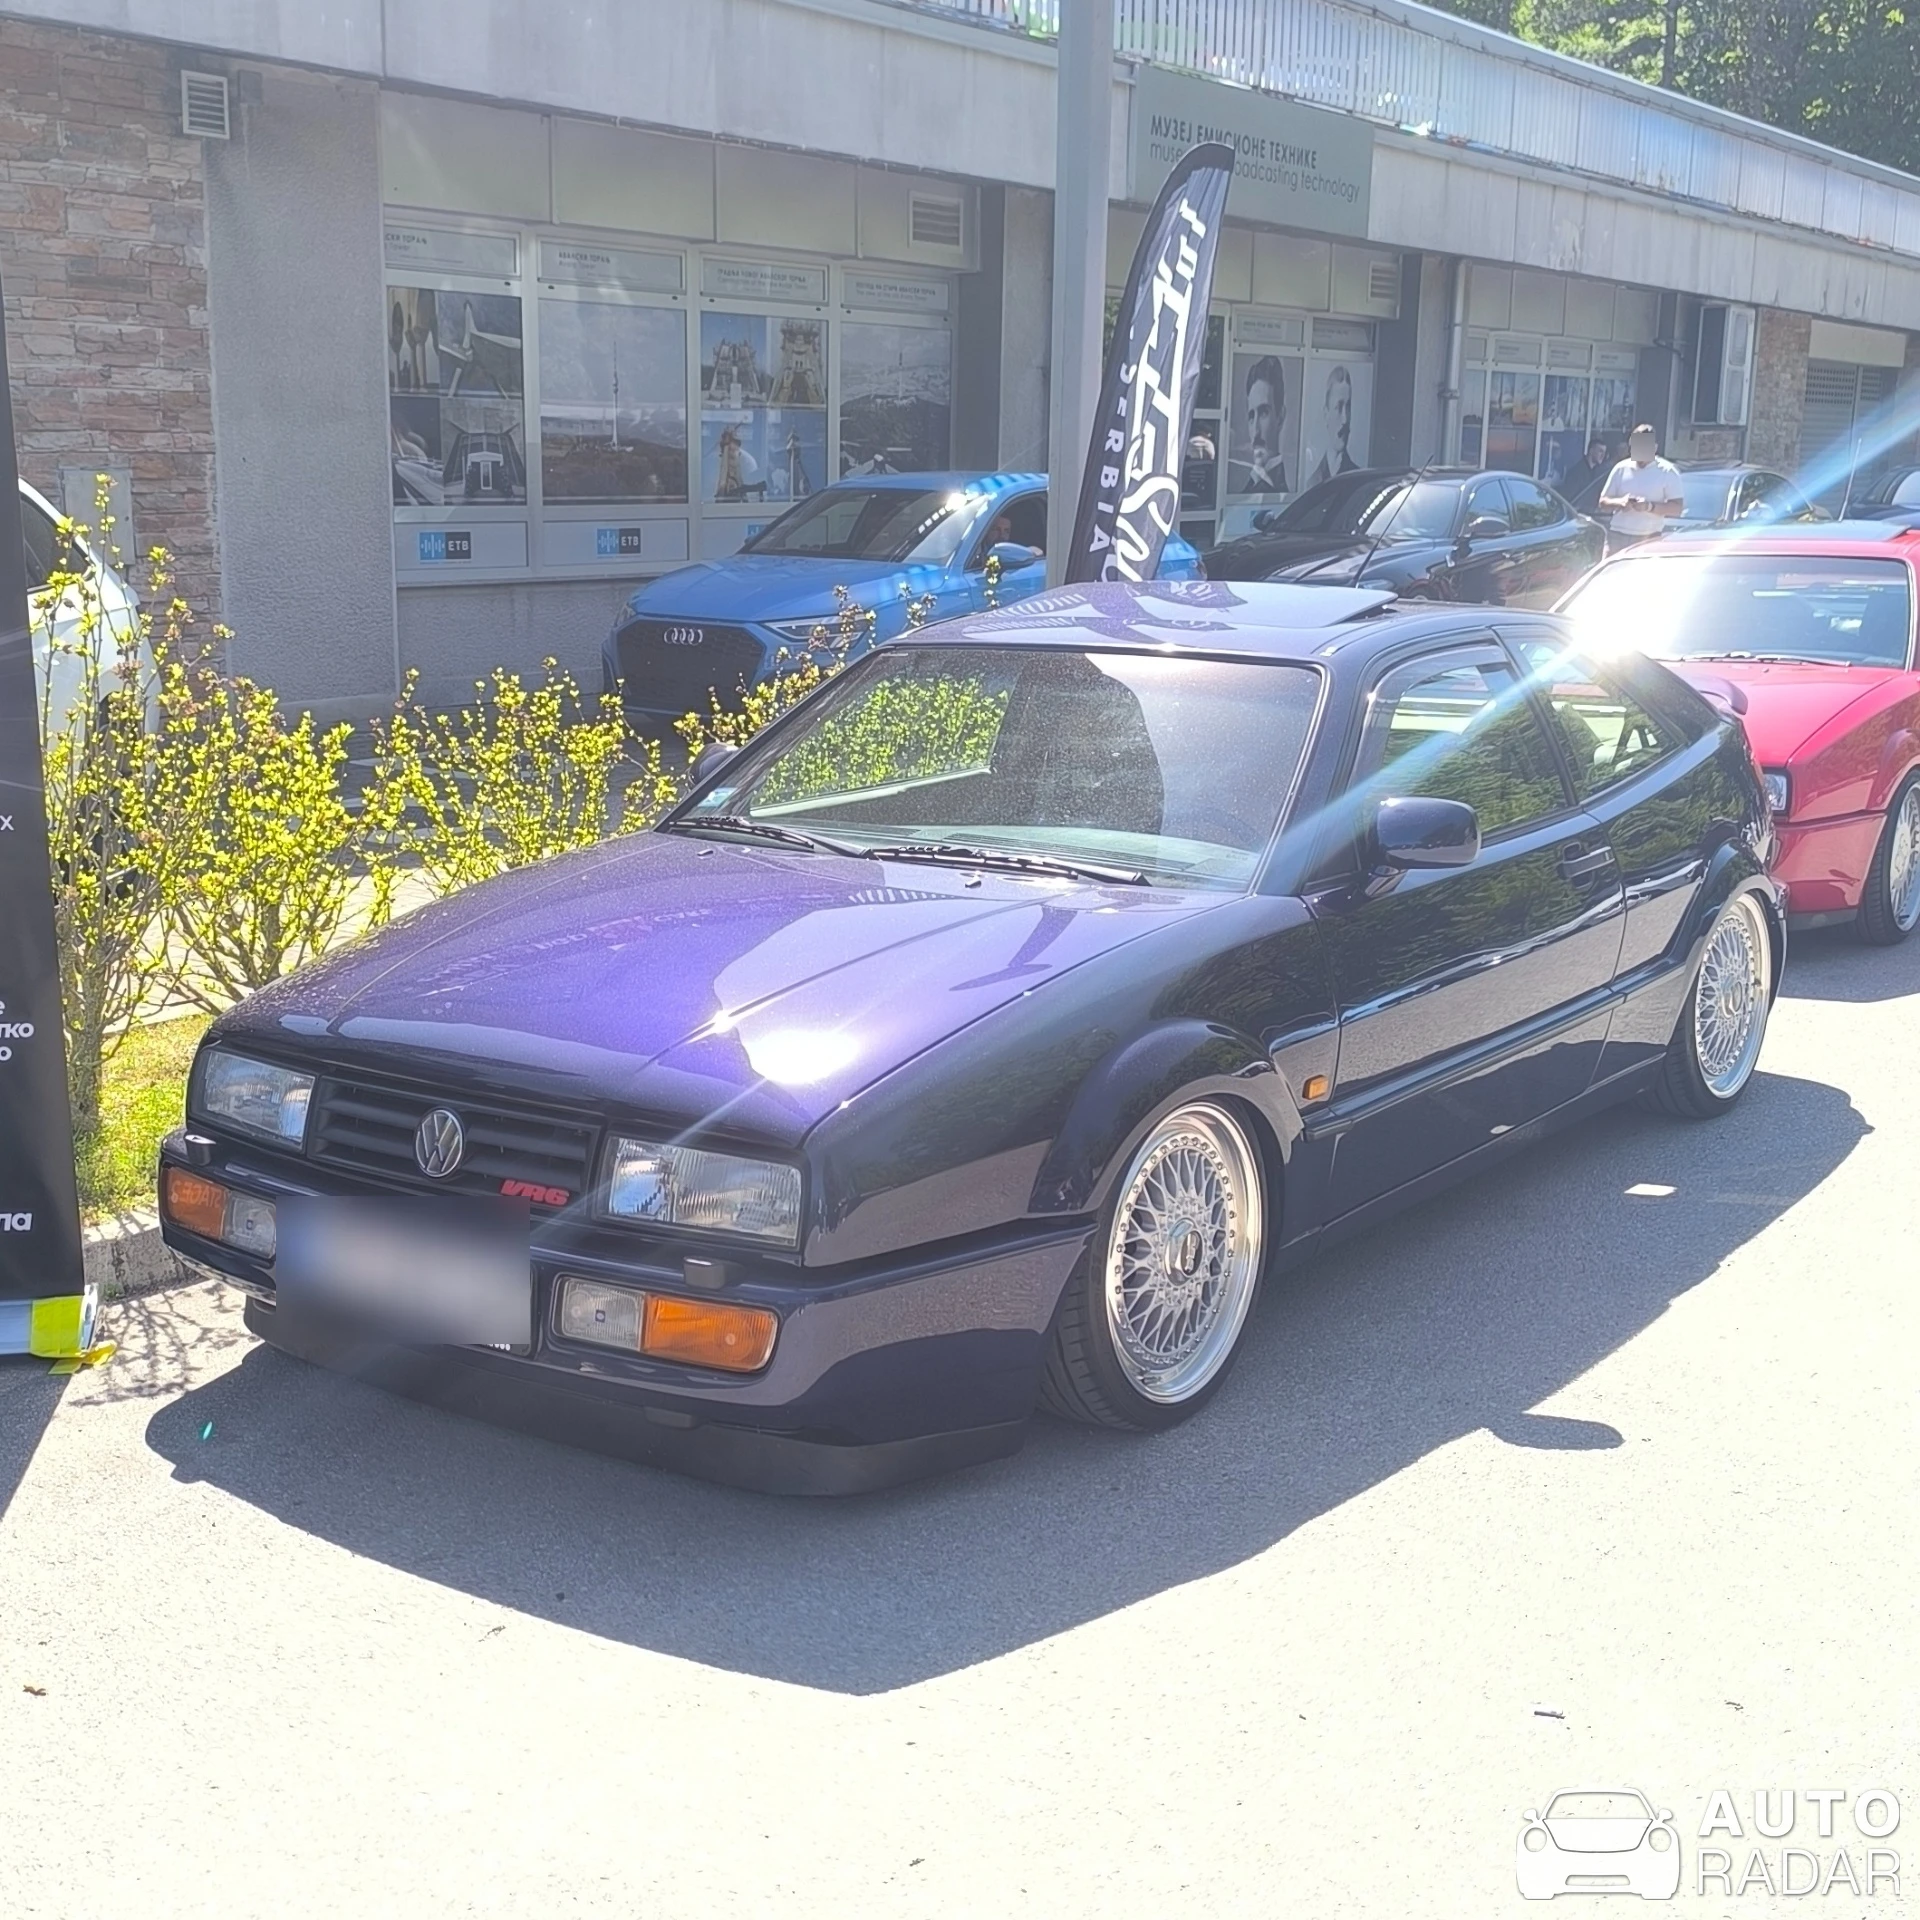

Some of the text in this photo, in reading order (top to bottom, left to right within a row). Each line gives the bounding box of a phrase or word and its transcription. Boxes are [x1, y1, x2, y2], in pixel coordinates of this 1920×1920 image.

[1150, 113, 1193, 144] МУЗЕЈ
[1269, 140, 1317, 170] ТЕХНИКЕ
[1150, 142, 1360, 204] muse oadcasting technology
[501, 1179, 570, 1206] VR6
